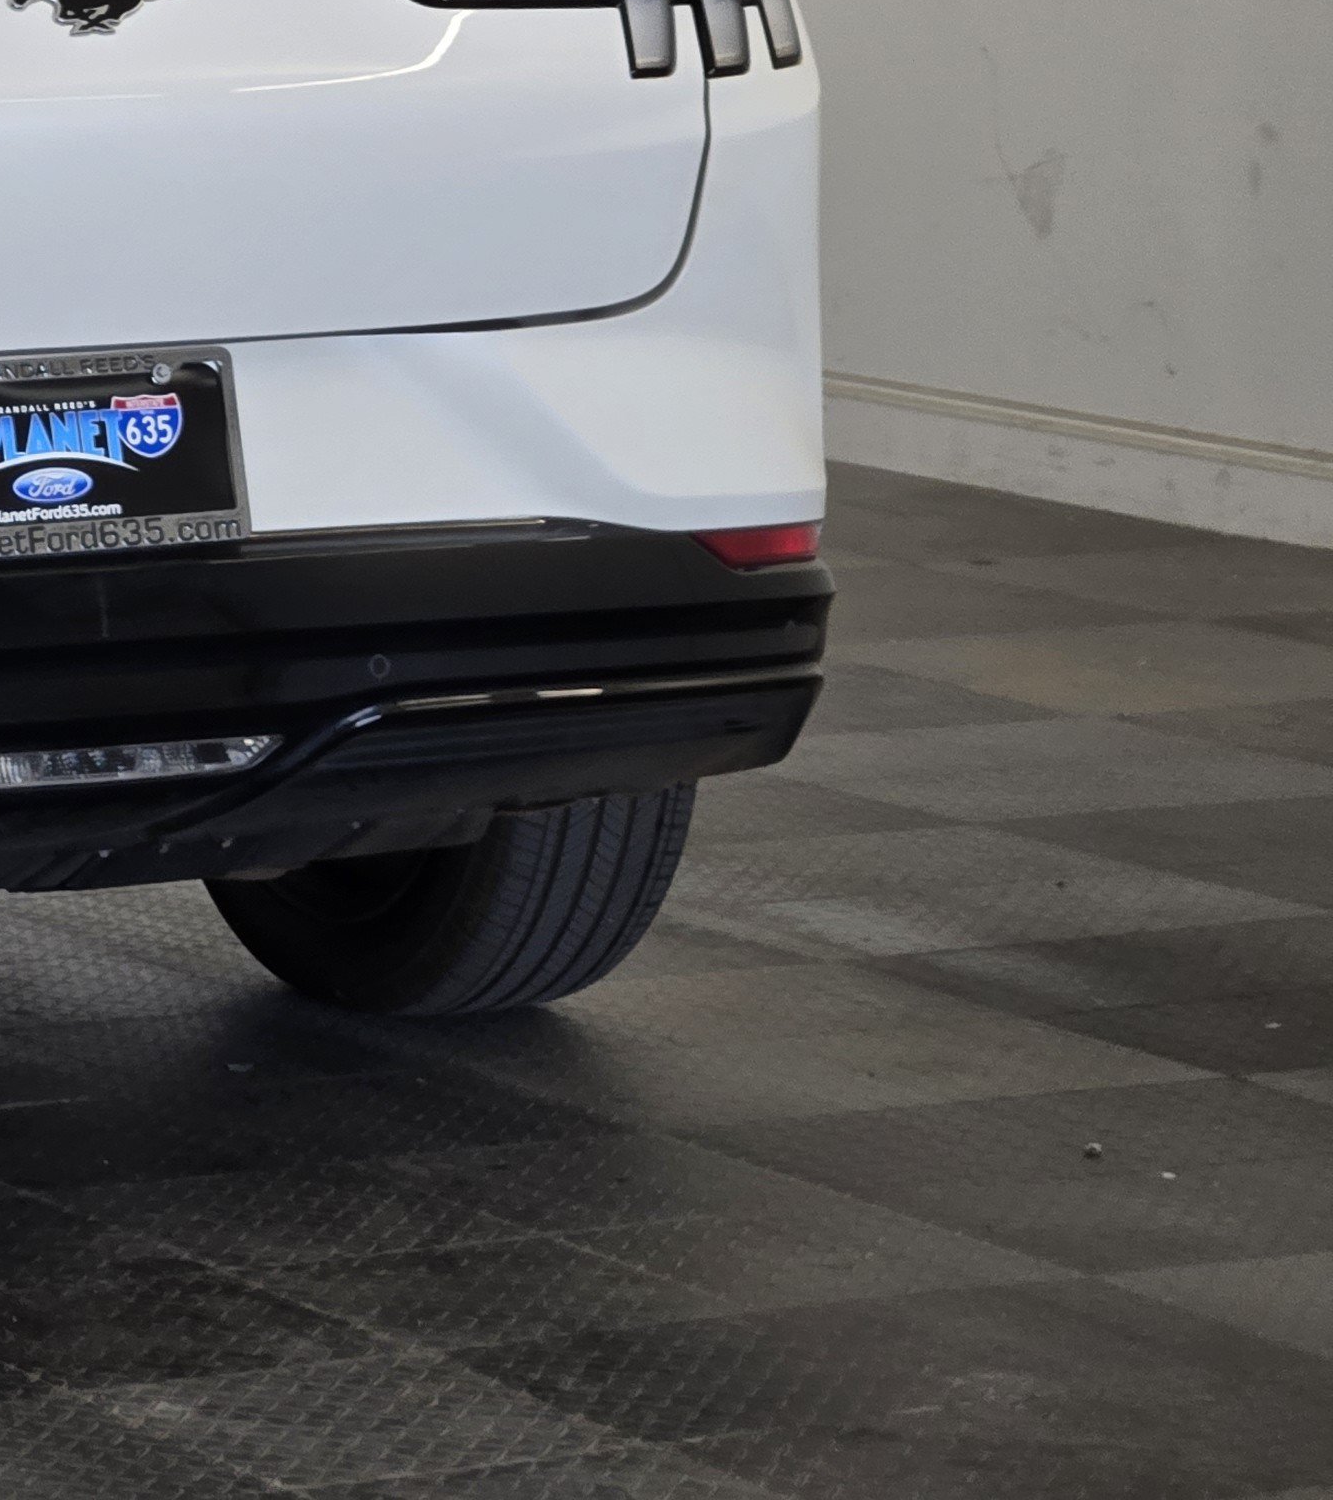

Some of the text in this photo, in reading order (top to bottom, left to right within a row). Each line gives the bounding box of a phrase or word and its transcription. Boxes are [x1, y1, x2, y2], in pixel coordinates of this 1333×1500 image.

[80, 354, 155, 375] REED'S
[54, 400, 96, 410] REED'S
[126, 414, 173, 446] 635
[28, 475, 76, 497] Ford
